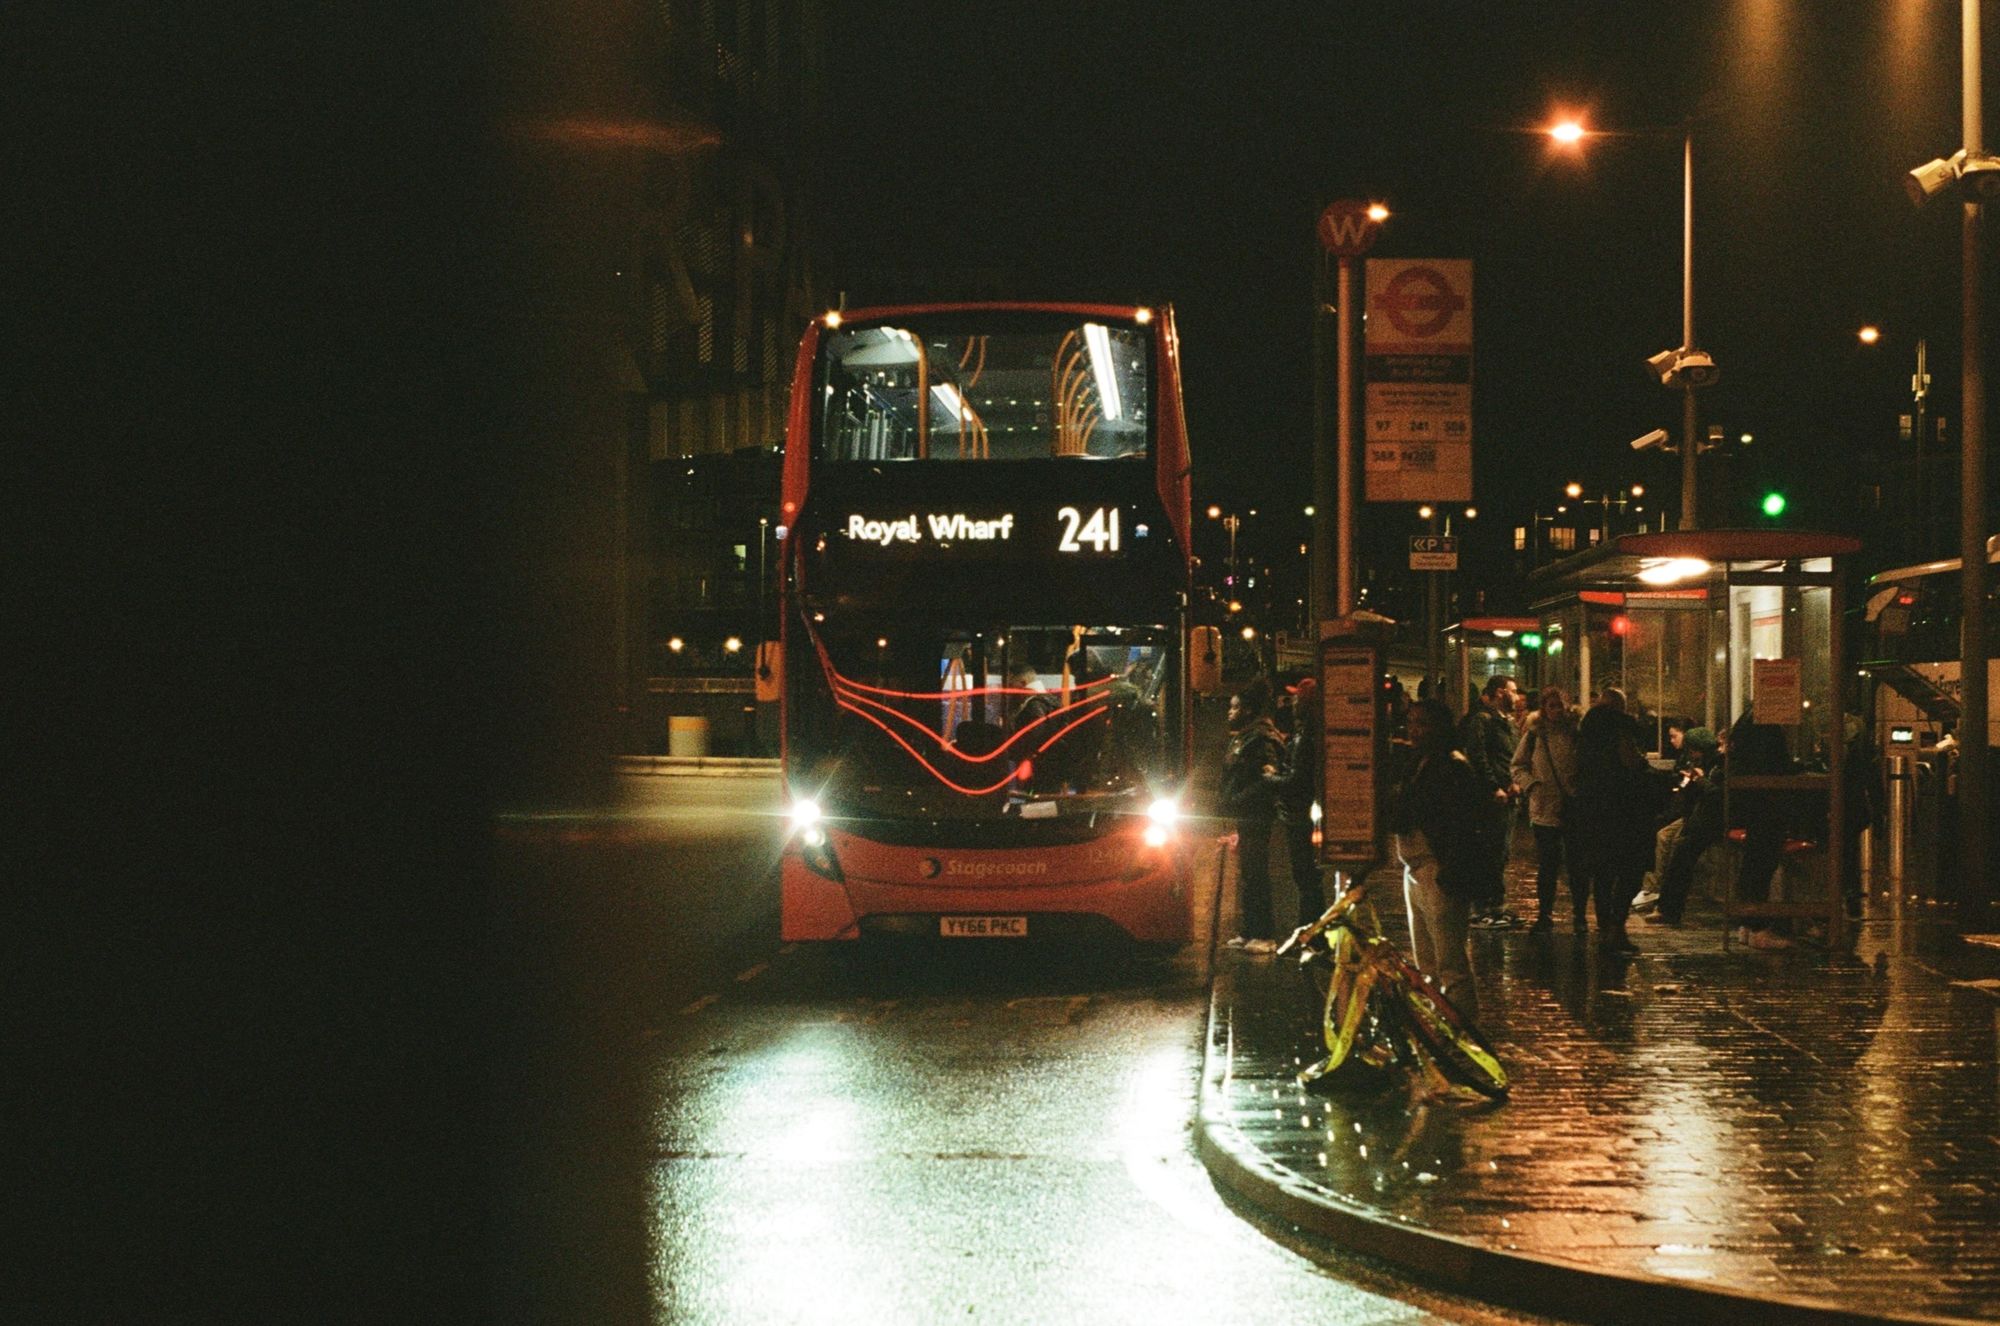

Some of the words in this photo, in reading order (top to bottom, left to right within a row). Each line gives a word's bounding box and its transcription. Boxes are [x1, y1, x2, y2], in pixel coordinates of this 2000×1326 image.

[1326, 214, 1366, 246] W
[849, 514, 921, 546] Royal
[928, 514, 1013, 540] Wharf
[1057, 507, 1120, 551] 241
[1427, 539, 1438, 551] P
[946, 860, 1047, 878] Stagecoach
[946, 919, 987, 933] YY66
[989, 919, 1021, 933] PKC
